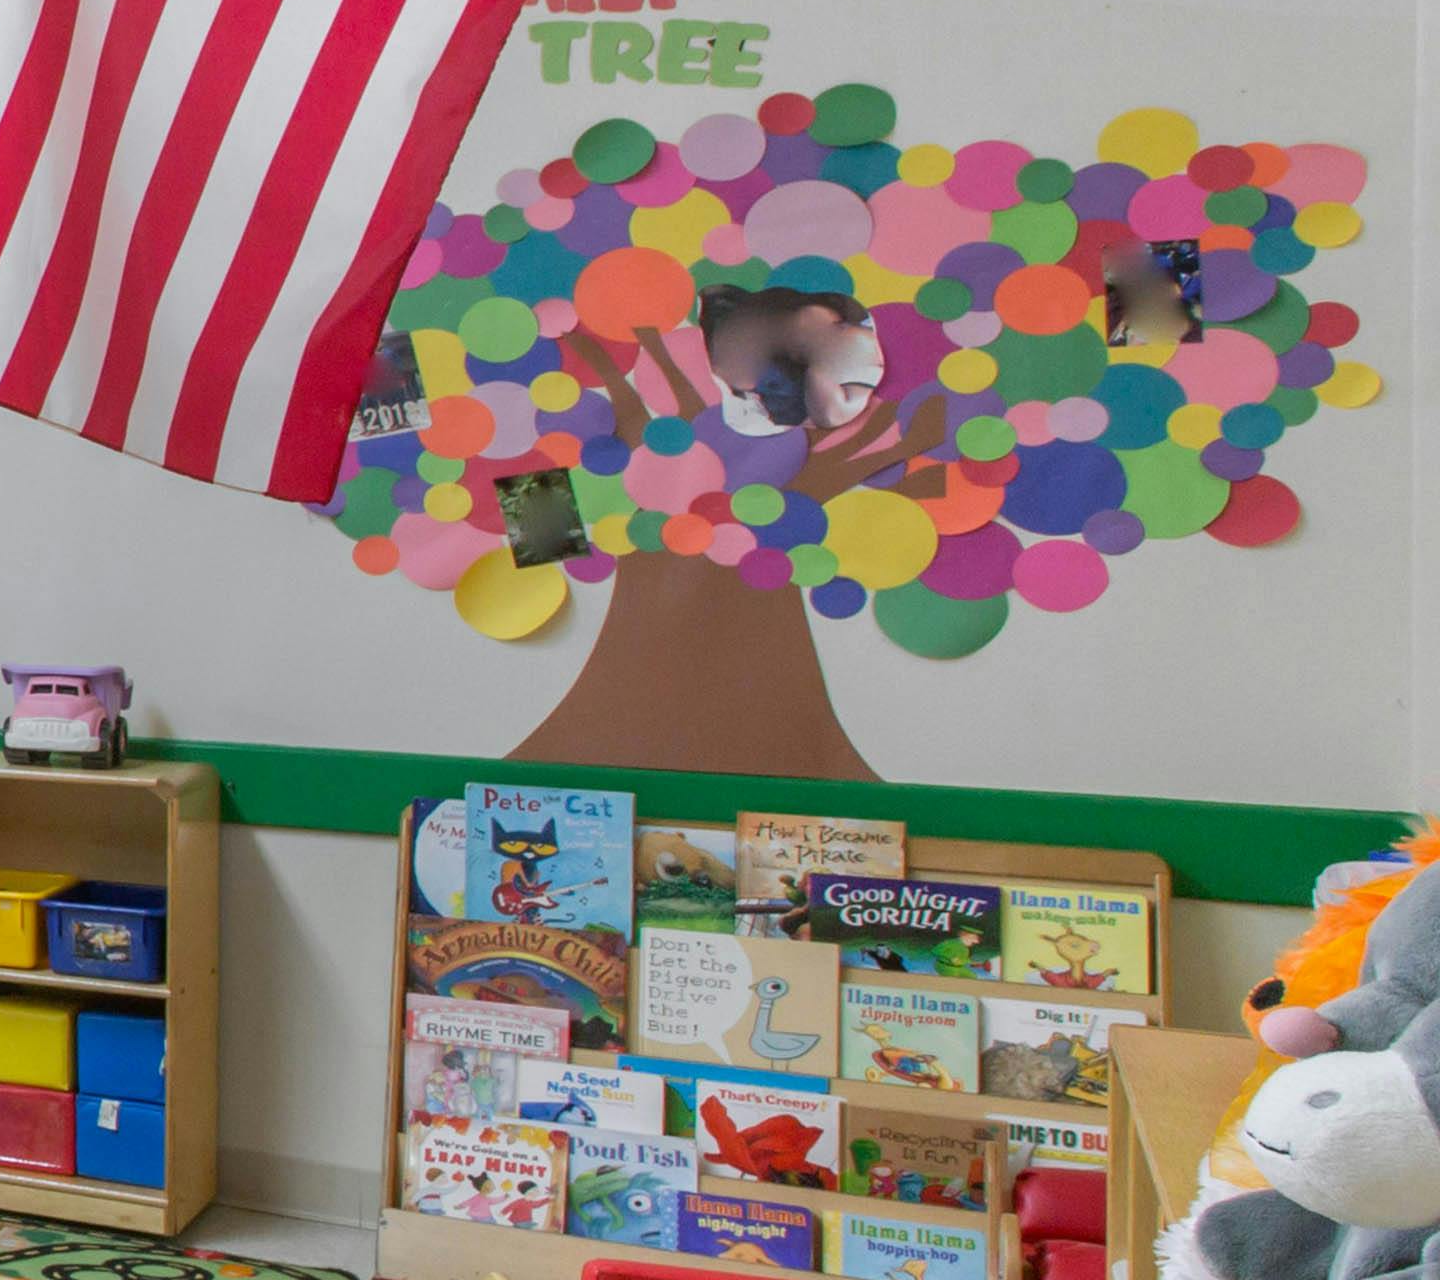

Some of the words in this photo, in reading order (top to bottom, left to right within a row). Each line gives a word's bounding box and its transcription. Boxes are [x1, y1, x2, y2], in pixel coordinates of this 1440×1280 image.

[528, 18, 771, 89] TREE
[483, 787, 542, 813] Pete
[564, 794, 614, 818] Cat
[426, 820, 447, 837] My
[755, 821, 797, 840] How
[800, 824, 813, 842] I
[817, 824, 894, 846] Became
[775, 847, 790, 860] a
[1010, 890, 1071, 910] llama
[1078, 891, 1140, 914] llama
[840, 904, 952, 932] GORILLA
[422, 925, 550, 966] Armadilly
[552, 937, 623, 987] Chili
[649, 936, 716, 956] Don't
[649, 953, 687, 969] Let
[699, 956, 737, 974] the
[649, 970, 732, 990] Pigeon
[648, 986, 717, 1004] Drive
[847, 988, 904, 1008] llama
[911, 994, 970, 1014] llama
[649, 1002, 689, 1019] the
[860, 1007, 957, 1028] zippity-zoom
[1035, 1008, 1064, 1024] Dig
[426, 1022, 493, 1042] RHYME
[499, 1030, 546, 1048] TIME
[647, 1019, 699, 1037] Bus!
[547, 1080, 601, 1098] Needs
[602, 1087, 635, 1102] Sun
[562, 1071, 574, 1082] A
[577, 1072, 621, 1088] Seed
[719, 1088, 763, 1104] That's
[765, 1095, 828, 1112] Creepy!
[433, 1138, 468, 1151] We're
[471, 1144, 509, 1159] Going
[512, 1152, 529, 1160] on
[879, 1126, 978, 1154] Recycling
[1049, 1127, 1078, 1148] TO
[423, 1148, 476, 1167] LEAF
[484, 1156, 548, 1178] HUNT
[569, 1135, 628, 1162] Pout
[635, 1143, 689, 1168] Fish
[924, 1149, 959, 1164] Fun
[686, 1194, 743, 1218] llama
[747, 1202, 808, 1227] llama
[697, 1216, 787, 1239] nighty-night
[850, 1219, 909, 1242] llama
[916, 1227, 977, 1251] llama
[866, 1238, 960, 1264] hoppity-hop
